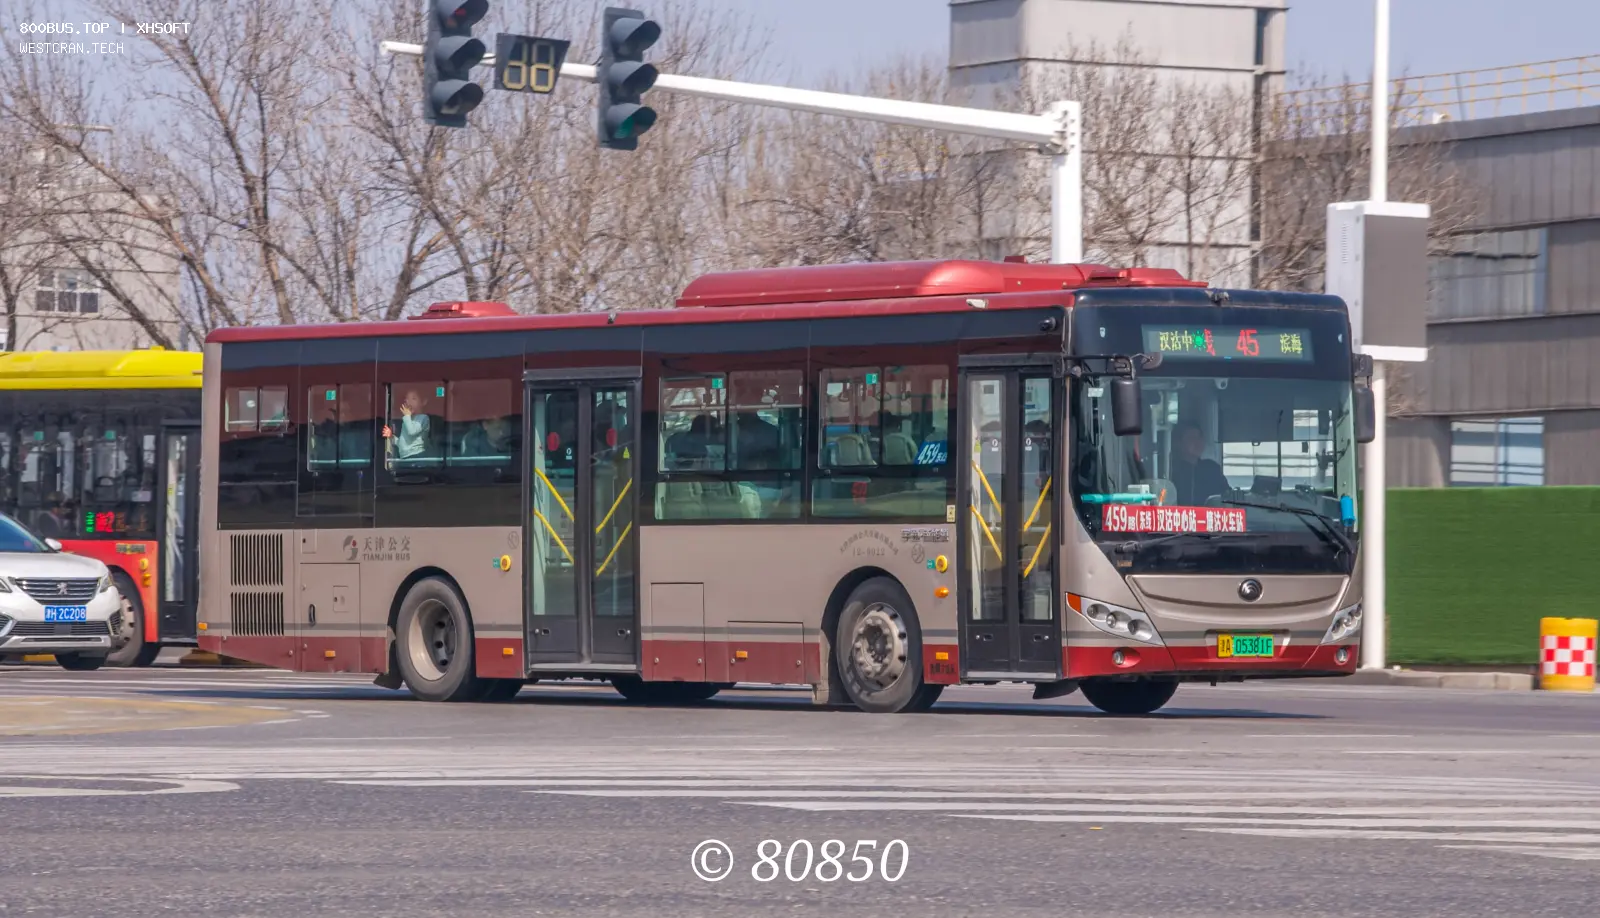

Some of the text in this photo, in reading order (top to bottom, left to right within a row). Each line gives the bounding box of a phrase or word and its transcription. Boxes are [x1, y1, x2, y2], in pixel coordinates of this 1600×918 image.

[1236, 329, 1260, 357] 45
[363, 534, 411, 551] 天津公交
[362, 553, 411, 561] TIANJIN BUS
